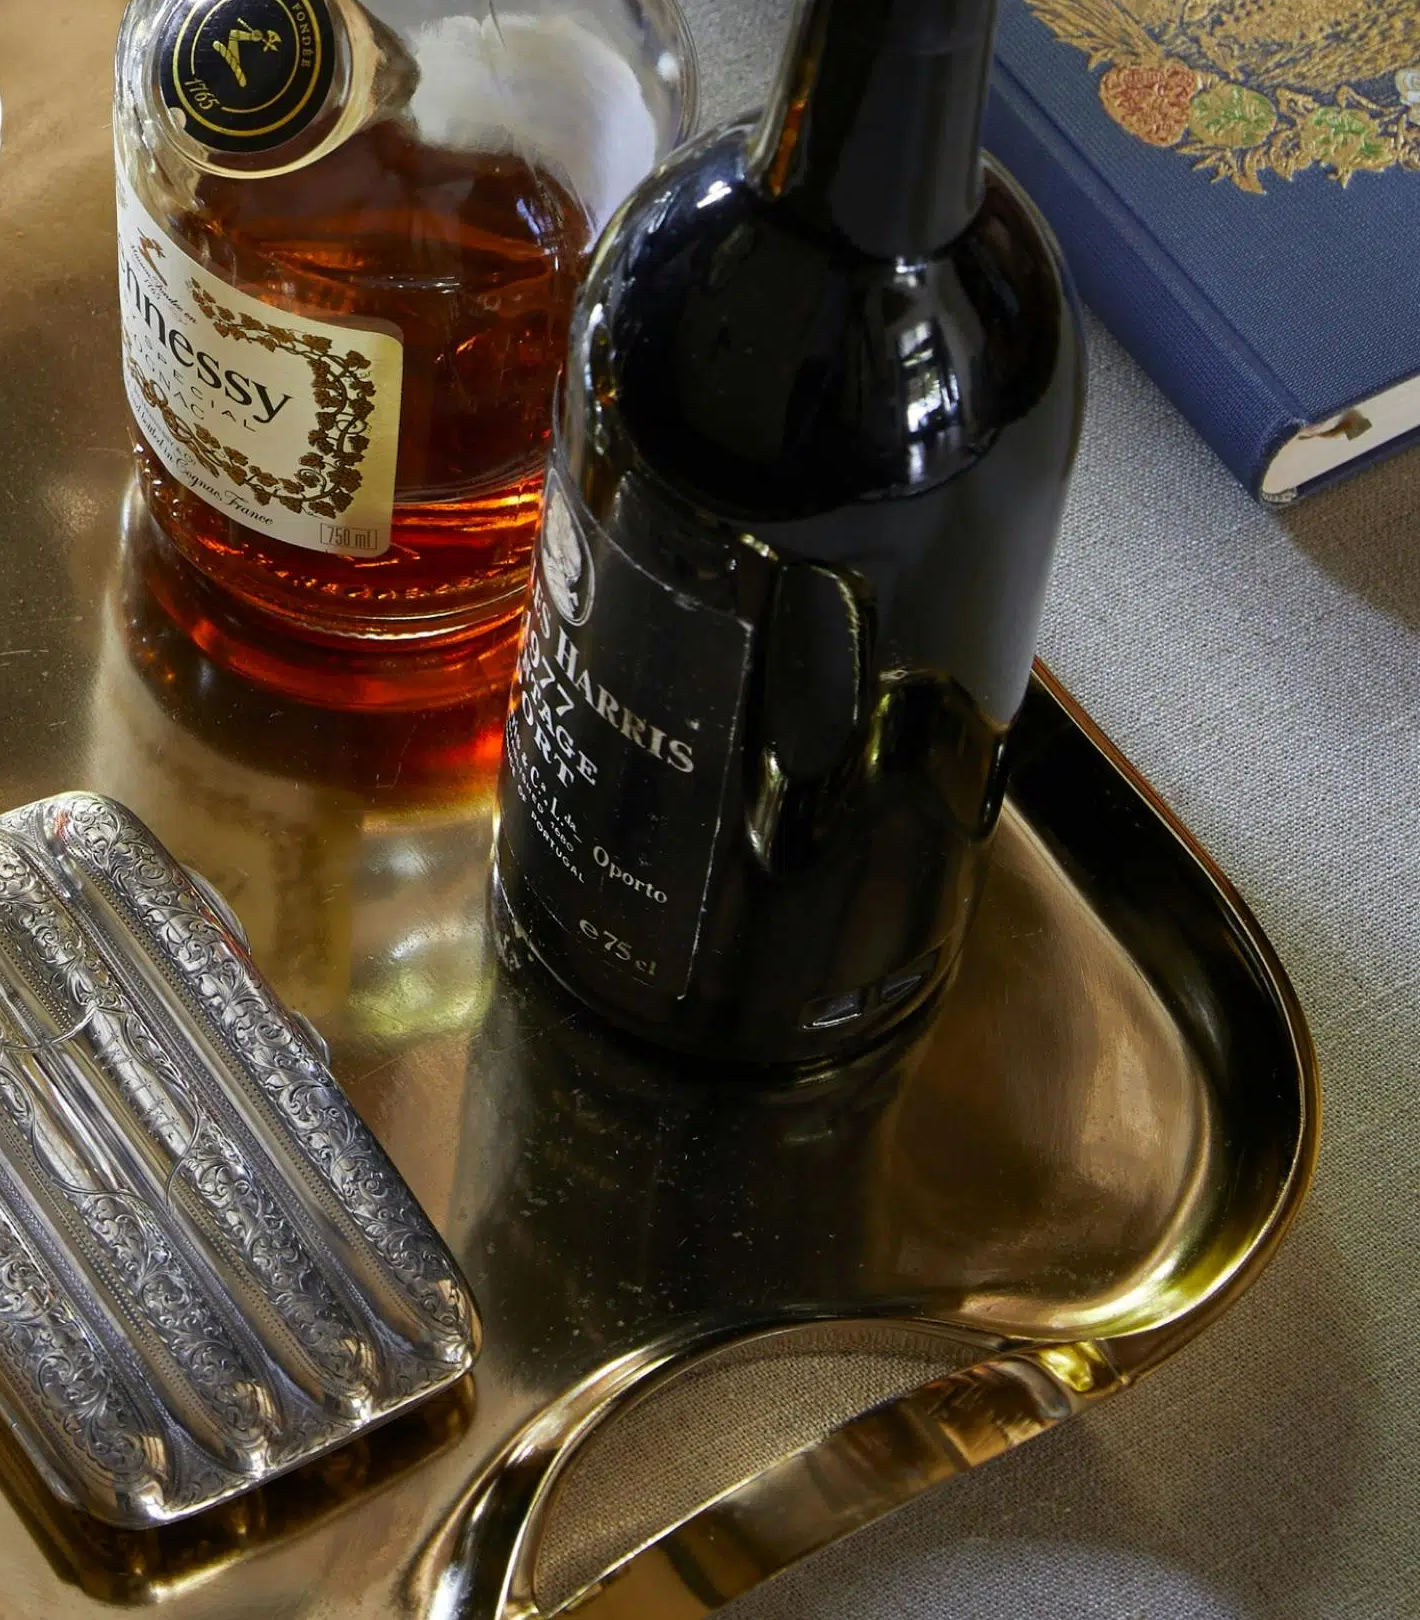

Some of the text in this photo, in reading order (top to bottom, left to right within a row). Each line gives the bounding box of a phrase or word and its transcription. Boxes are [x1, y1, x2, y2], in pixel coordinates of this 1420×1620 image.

[183, 78, 220, 111] 1765
[123, 242, 293, 424] nnessy
[224, 489, 275, 526] France
[329, 531, 351, 548] 750
[554, 624, 695, 774] HARRIS
[518, 687, 576, 789] ORT
[531, 810, 586, 884] PORTUGAL
[593, 845, 669, 904] Oporto
